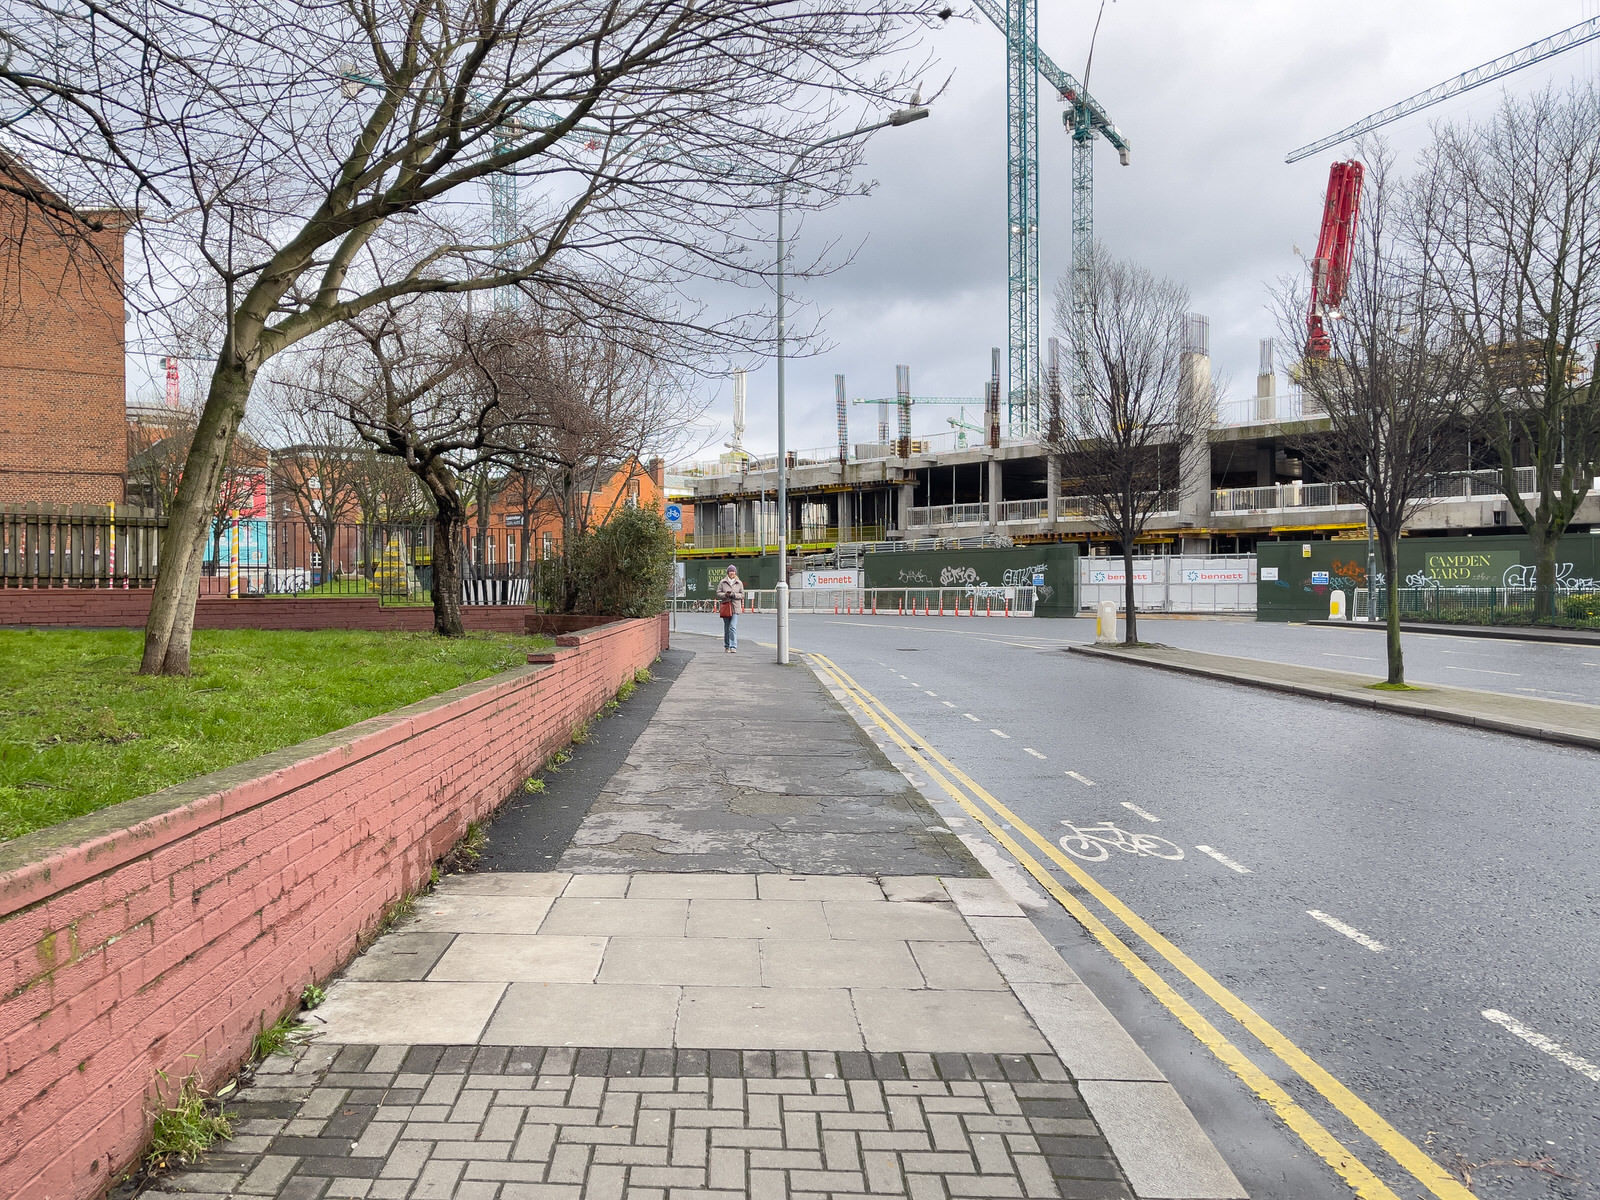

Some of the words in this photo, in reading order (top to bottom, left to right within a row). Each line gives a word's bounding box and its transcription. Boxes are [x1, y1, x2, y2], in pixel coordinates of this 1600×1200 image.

[1429, 555, 1491, 567] CAMDEN
[1430, 568, 1471, 579] YARD
[818, 576, 852, 584] bennett
